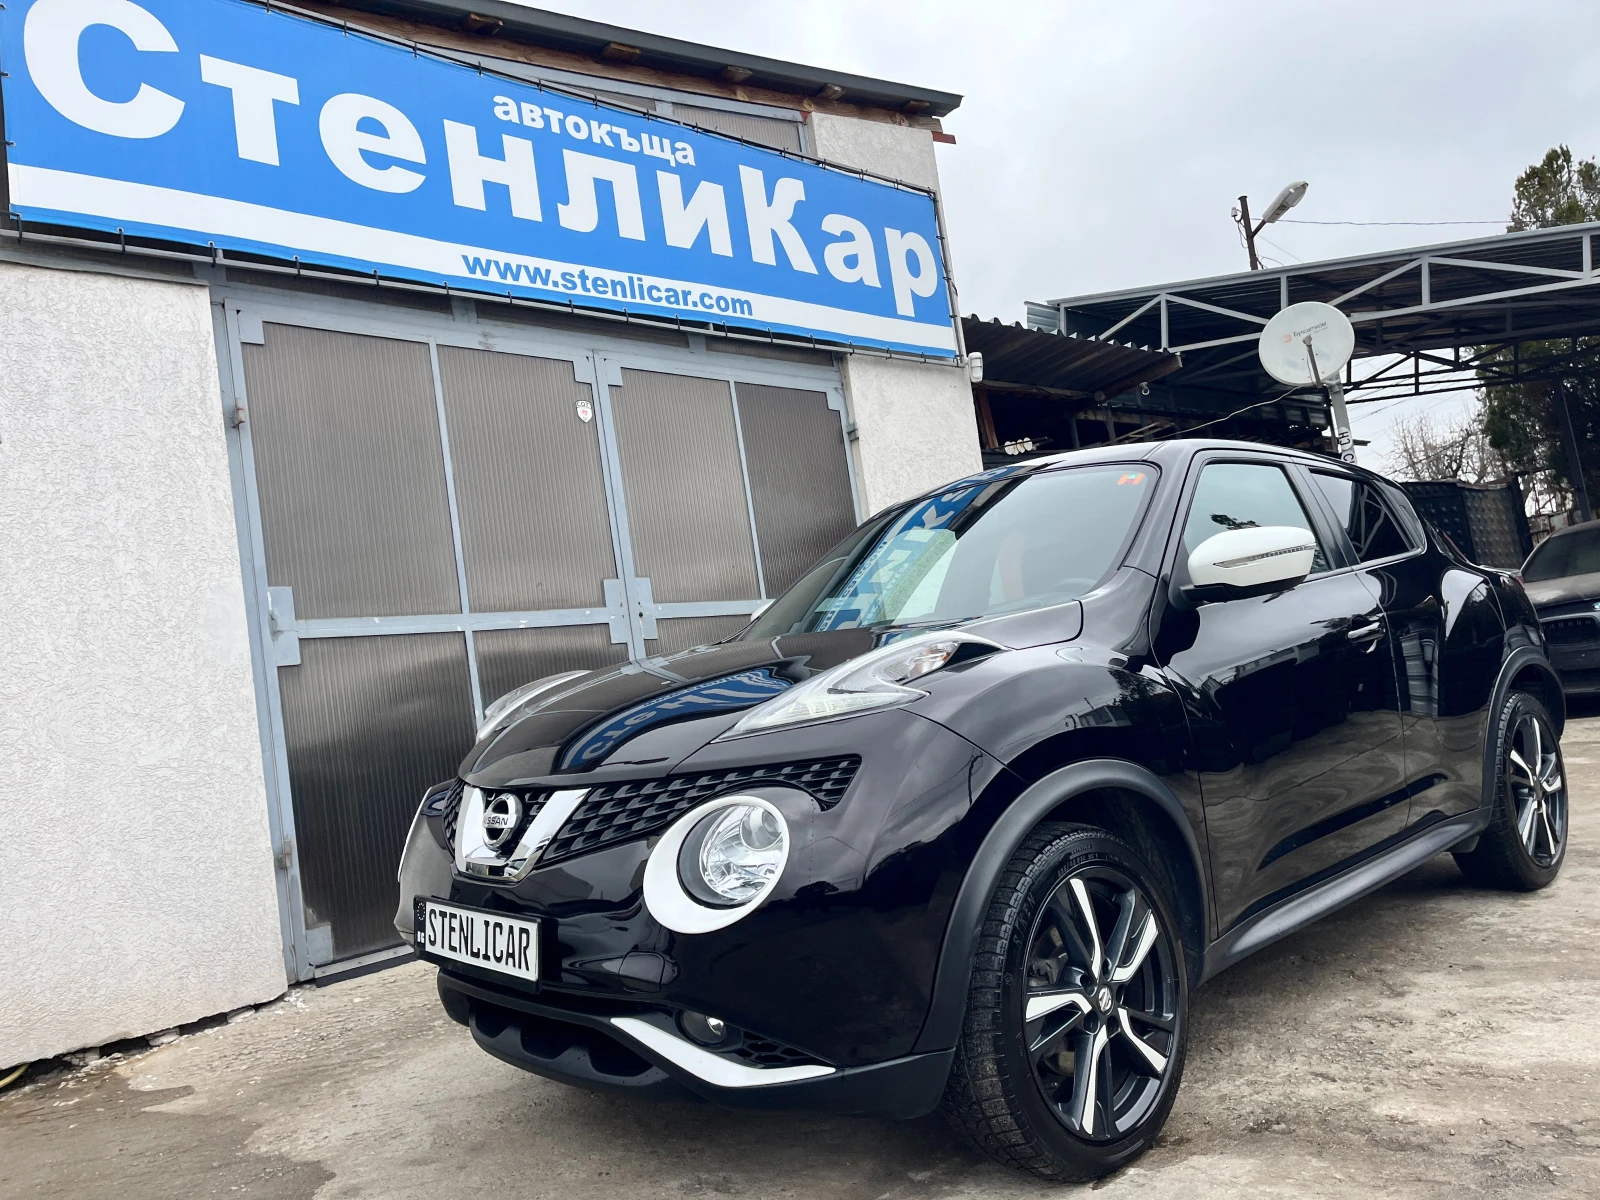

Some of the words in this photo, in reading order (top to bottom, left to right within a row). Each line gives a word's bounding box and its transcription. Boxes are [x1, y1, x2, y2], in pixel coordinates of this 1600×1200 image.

[23, 0, 939, 318] СтенлиКар
[493, 95, 696, 167] автокъща
[461, 254, 754, 317] www.stenlicar.com
[428, 908, 530, 972] STENLICAR
